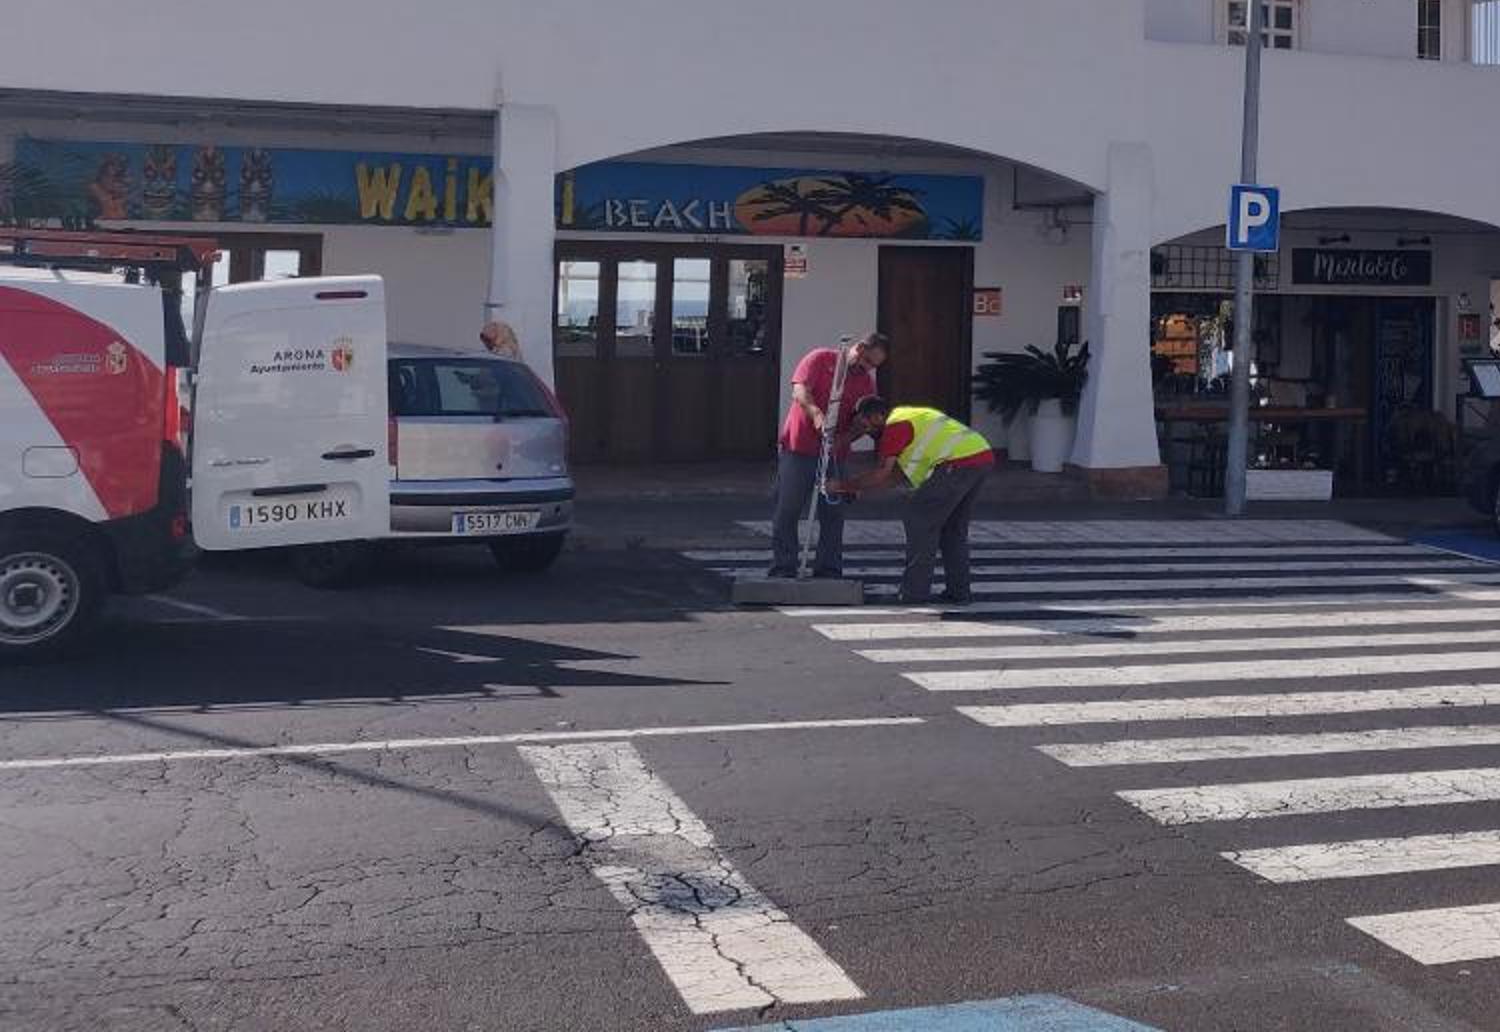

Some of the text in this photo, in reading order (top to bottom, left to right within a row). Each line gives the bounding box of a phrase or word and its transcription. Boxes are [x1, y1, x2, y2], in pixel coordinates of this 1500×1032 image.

[604, 199, 733, 231] BEACH
[1238, 191, 1271, 243] P
[273, 349, 326, 361] ARONA
[246, 500, 347, 524] 1590 KHX
